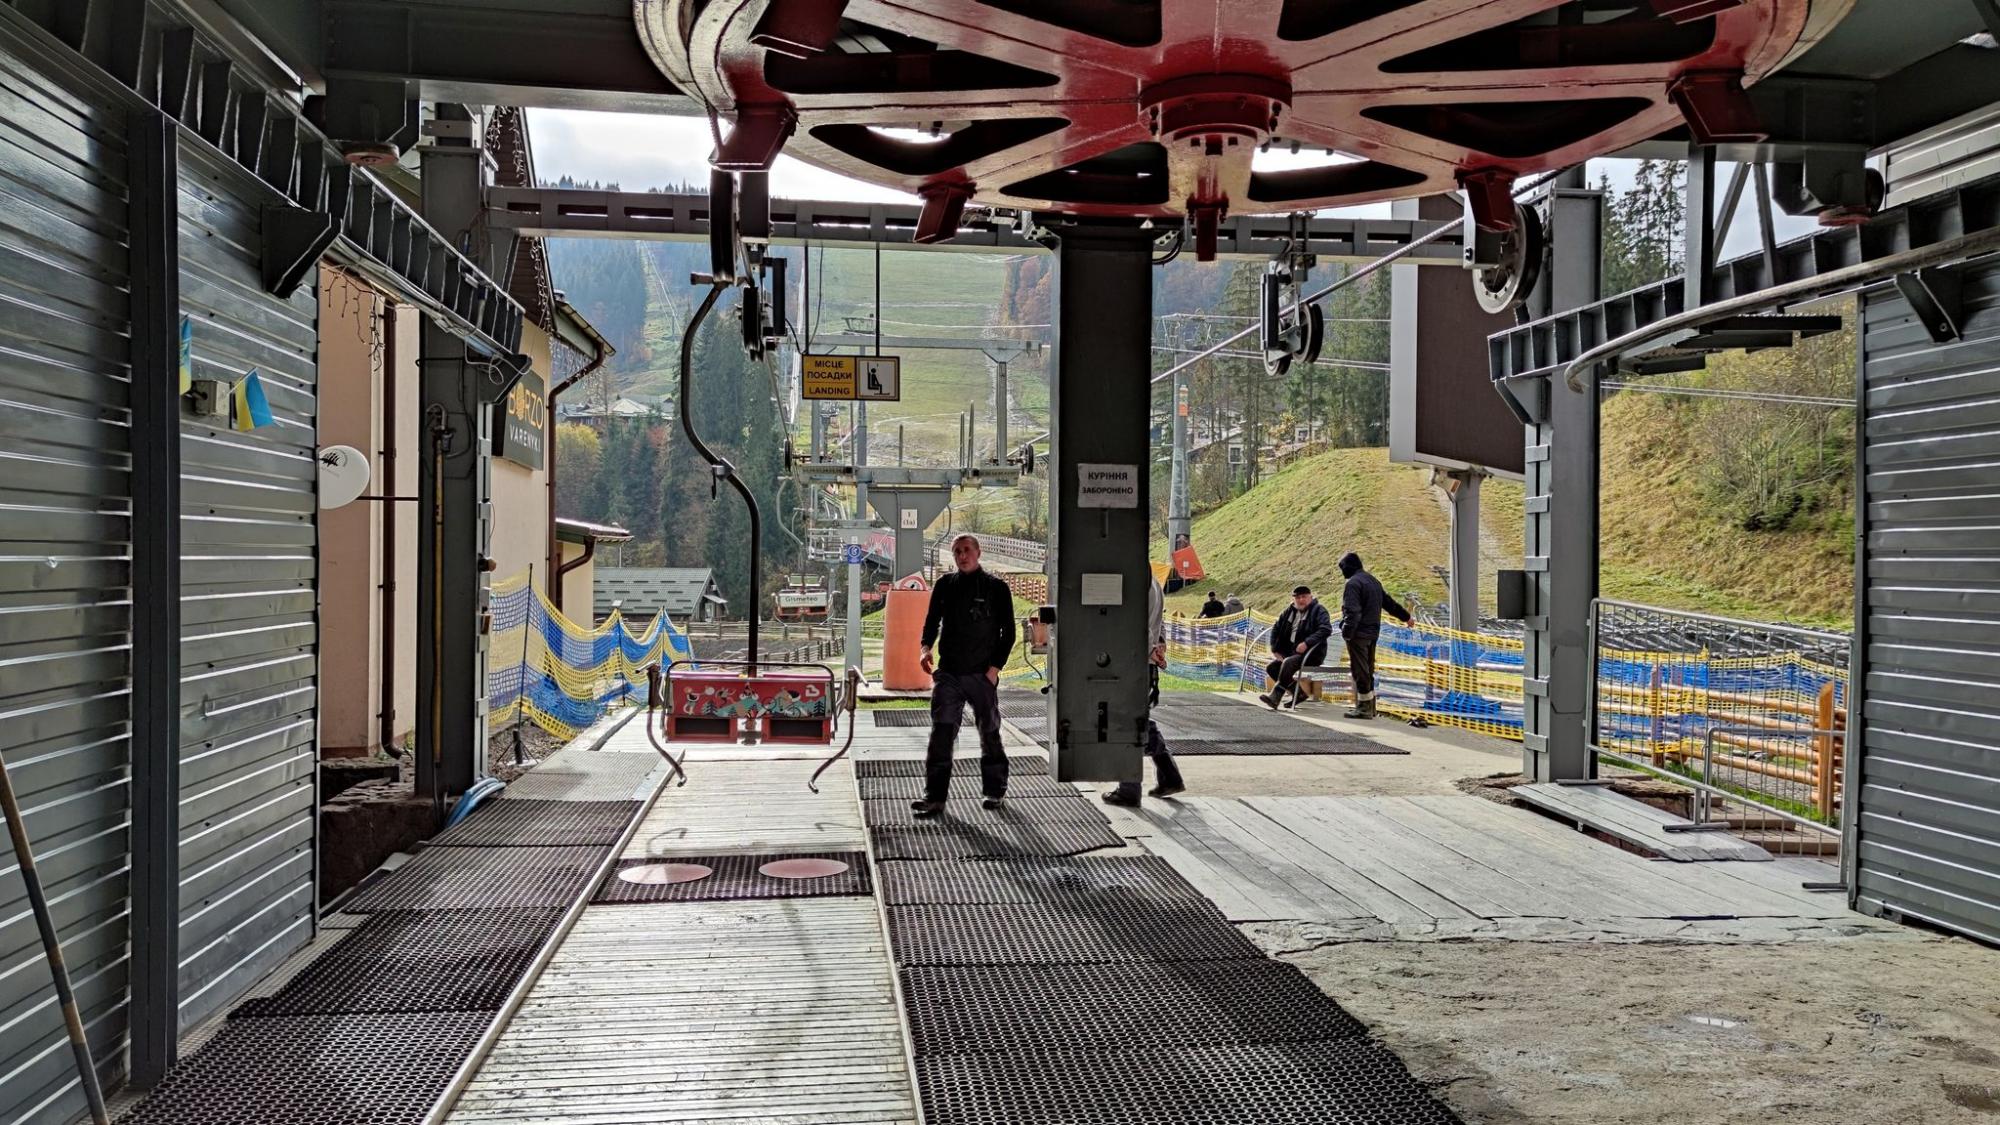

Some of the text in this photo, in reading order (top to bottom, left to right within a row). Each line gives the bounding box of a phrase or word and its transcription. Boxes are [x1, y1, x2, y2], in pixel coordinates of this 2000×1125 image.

[814, 360, 844, 369] МІСЦЕ
[807, 371, 852, 381] ПОСАДКИ
[809, 386, 850, 395] LANDING
[509, 423, 541, 452] VARENYKI
[1088, 472, 1128, 481] КУРІННЯ
[1082, 486, 1133, 495] ЗАБОРОНЕНО
